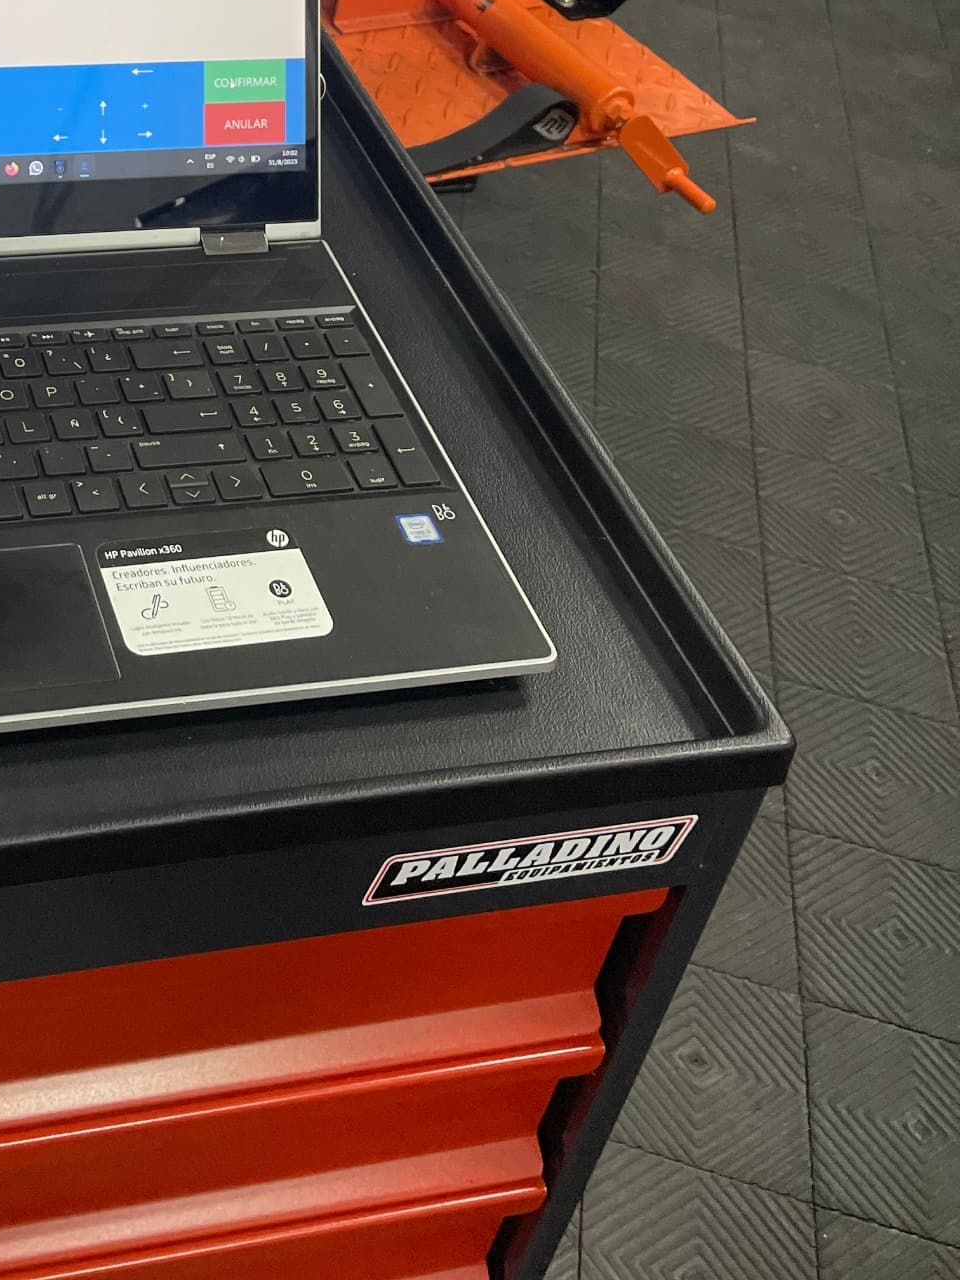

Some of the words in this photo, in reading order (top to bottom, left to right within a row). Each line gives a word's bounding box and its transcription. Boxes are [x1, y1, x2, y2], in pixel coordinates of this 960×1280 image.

[214, 76, 278, 89] CONFIRMAR
[224, 117, 268, 130] ANULAR
[233, 374, 242, 384] 7
[275, 371, 287, 382] 8
[316, 368, 327, 379] 9
[0, 389, 15, 401] O
[46, 386, 58, 397] P
[249, 405, 259, 416] 4
[290, 402, 302, 413] 5
[332, 399, 344, 409] 6
[22, 421, 35, 433] L
[70, 418, 80, 429] Ñ
[264, 438, 273, 448] 1
[306, 435, 319, 446] 2
[348, 431, 360, 441] 3
[300, 470, 313, 481] 0
[104, 550, 119, 560] HP
[120, 547, 158, 558] Pavilion
[158, 544, 183, 555] x360
[266, 529, 290, 548] hp
[171, 559, 257, 574] Influenciadores.
[116, 579, 162, 592] Escriban
[164, 579, 177, 587] su
[179, 574, 217, 585] futuro.
[391, 826, 676, 886] PALLADINO
[504, 851, 655, 882] EQUIPAMIENTOS
